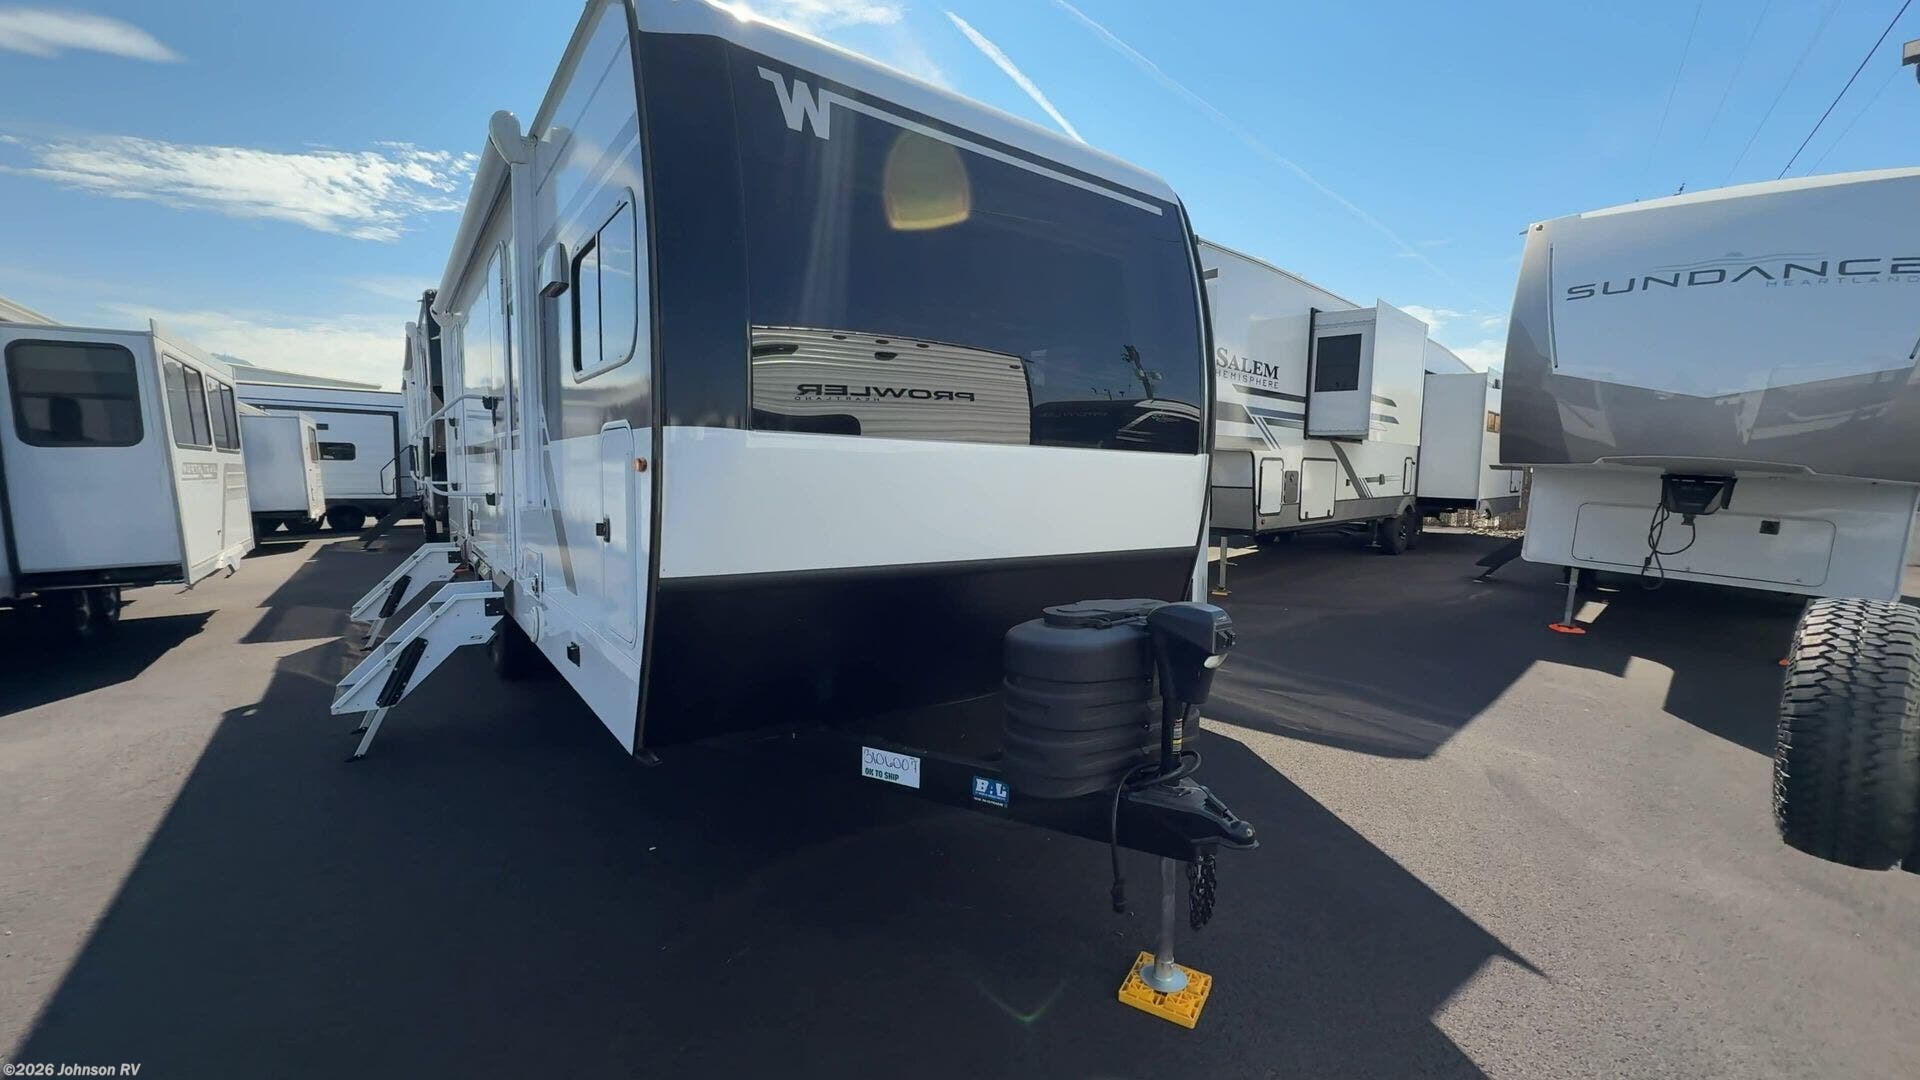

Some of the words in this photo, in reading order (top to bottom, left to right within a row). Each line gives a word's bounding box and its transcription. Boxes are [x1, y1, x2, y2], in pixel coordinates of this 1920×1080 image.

[758, 66, 831, 140] W
[1567, 257, 1920, 301] SUNDANCE
[1766, 275, 1920, 288] HEARTLAND
[1216, 347, 1280, 380] SALEM
[1216, 369, 1279, 389] HEMISPHERE
[865, 767, 874, 776] OK
[875, 769, 883, 778] TO
[884, 771, 900, 781] SHIP
